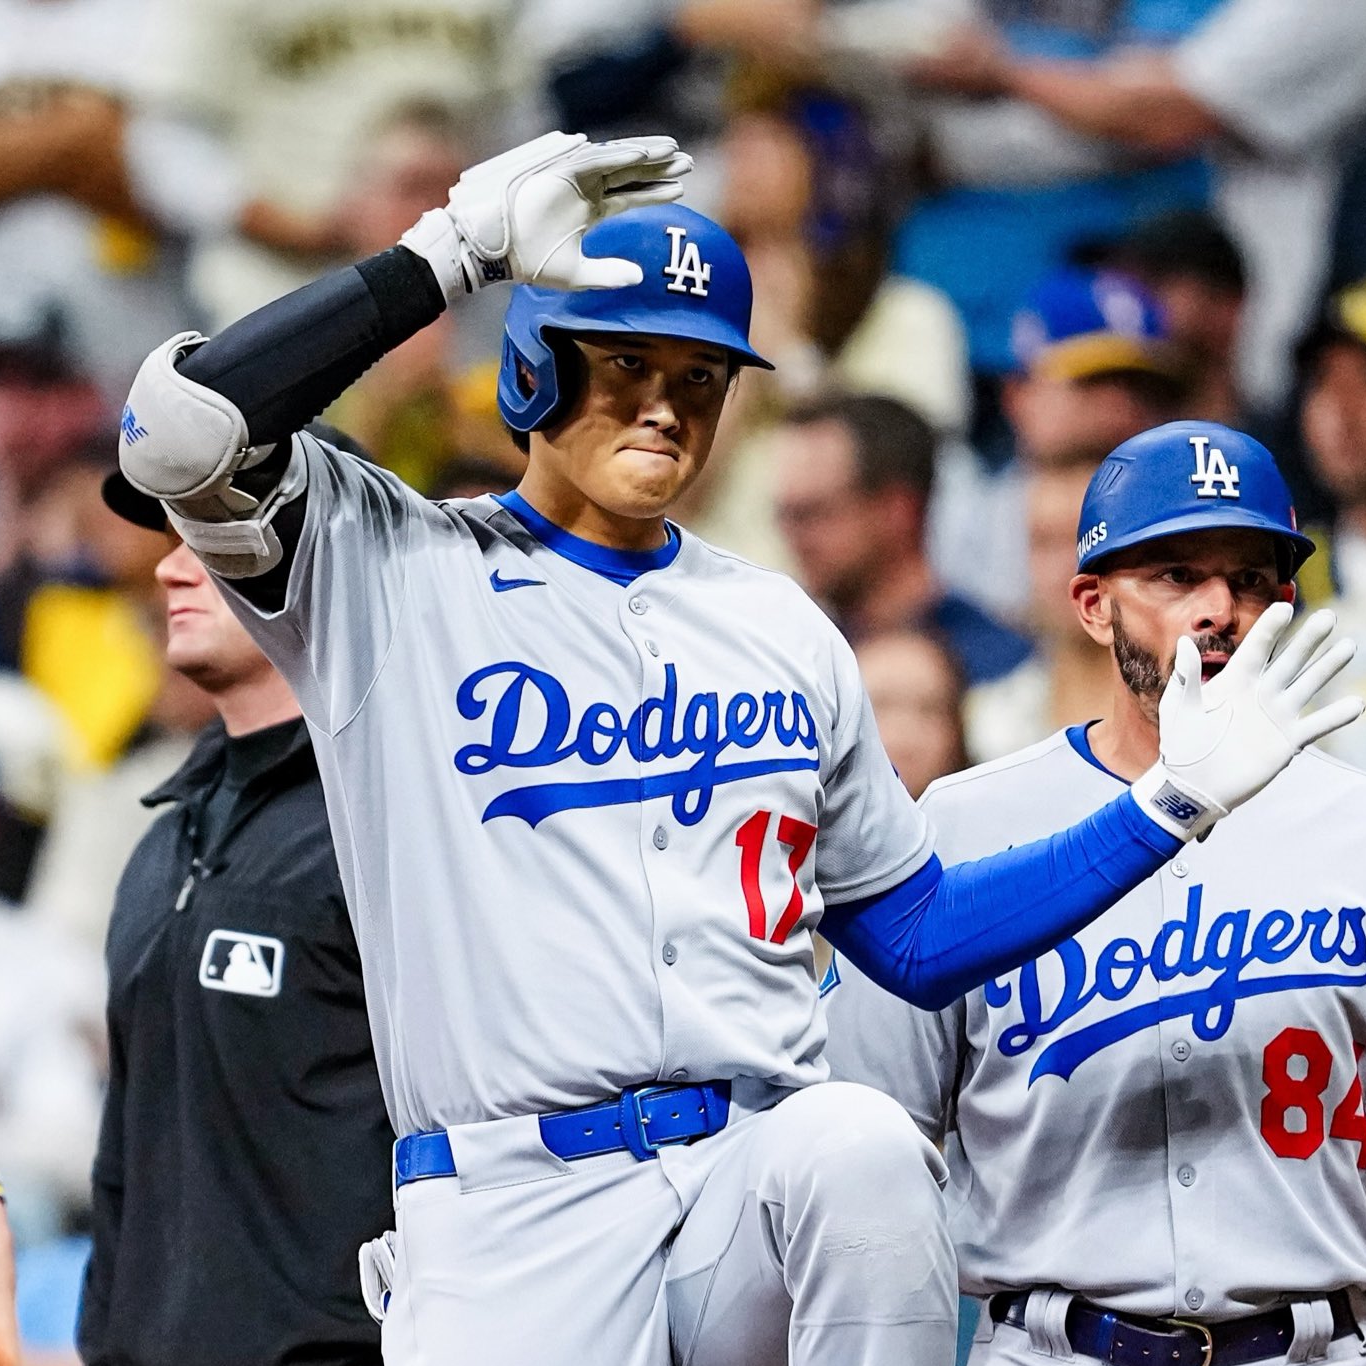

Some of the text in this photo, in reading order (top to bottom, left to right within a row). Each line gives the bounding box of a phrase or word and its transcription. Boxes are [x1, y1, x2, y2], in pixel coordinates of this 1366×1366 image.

[664, 226, 711, 297] LA
[1189, 436, 1240, 498] LA
[454, 661, 820, 827] Dodgers
[735, 810, 818, 945] 17
